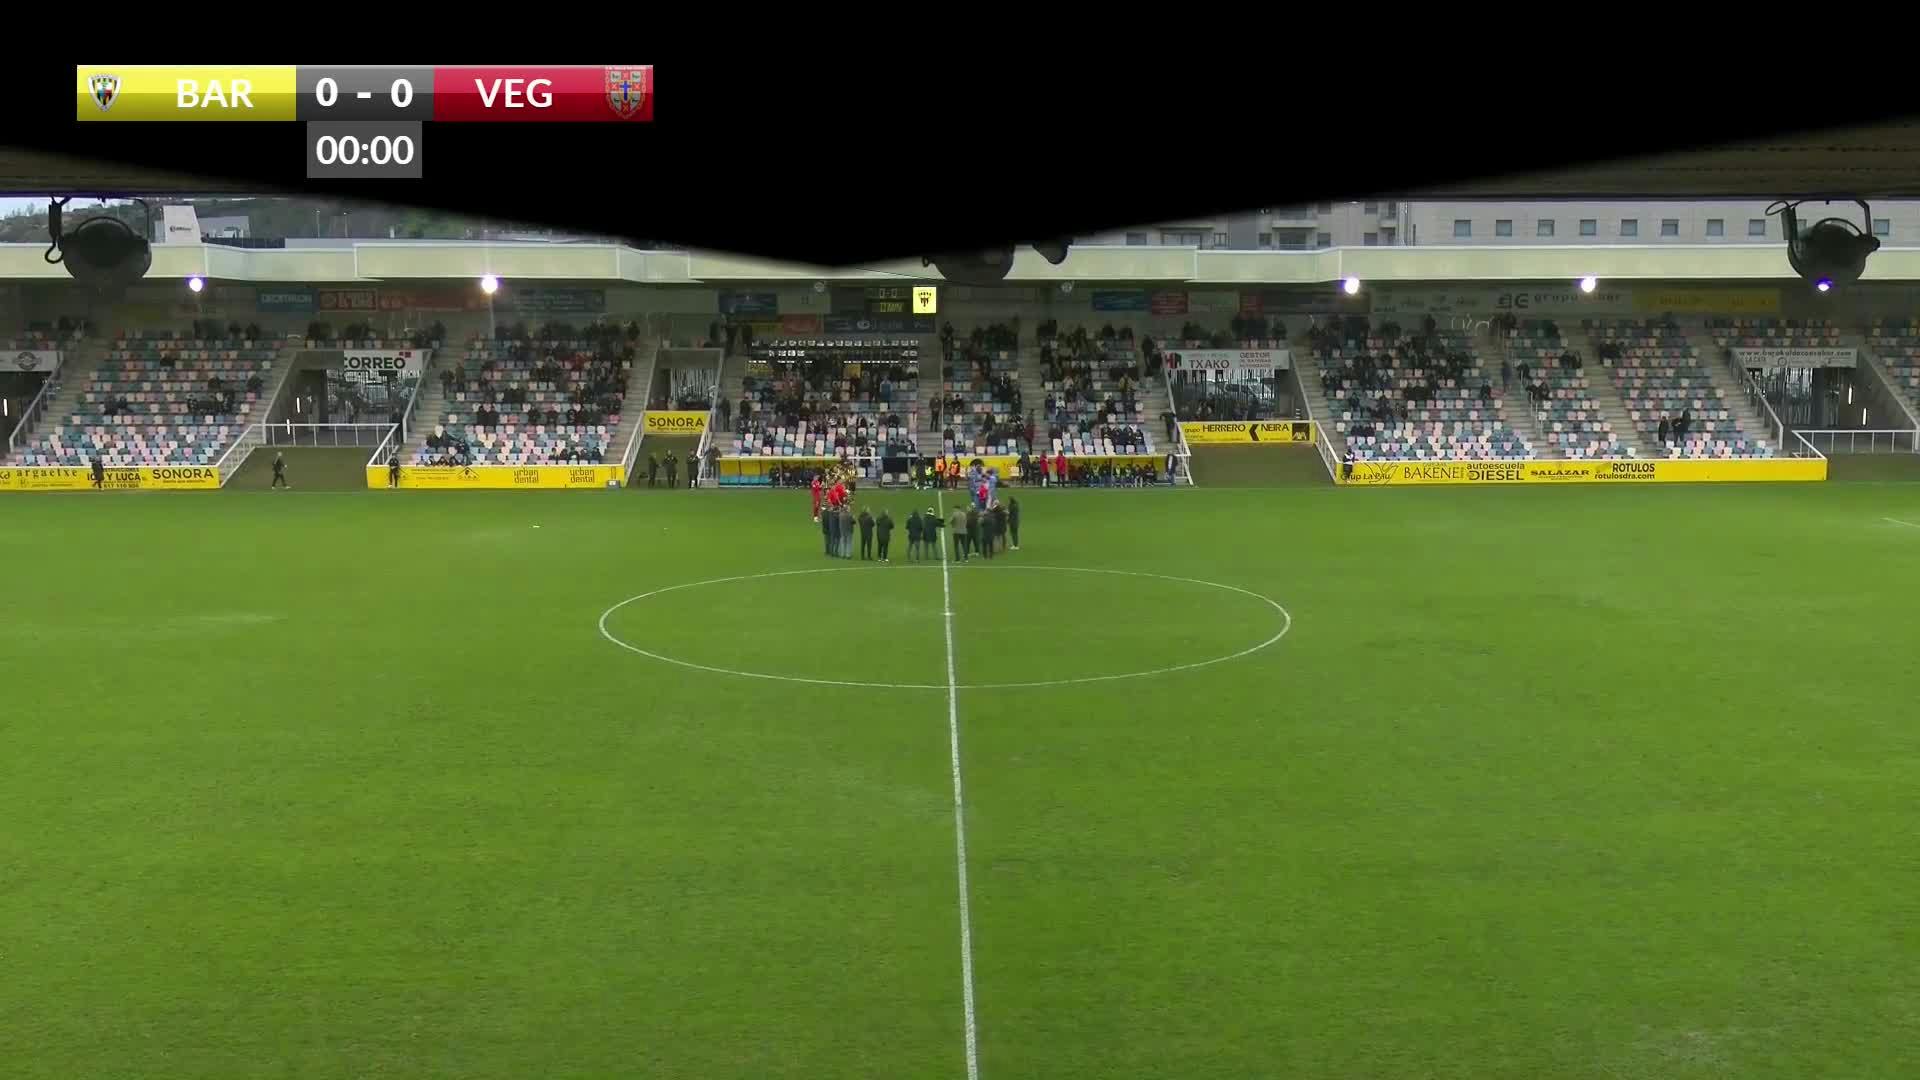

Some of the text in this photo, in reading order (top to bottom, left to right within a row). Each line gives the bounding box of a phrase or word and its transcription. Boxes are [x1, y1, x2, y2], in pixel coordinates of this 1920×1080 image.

[1189, 359, 1230, 369] TXAKO
[649, 417, 704, 427] SONORA
[1203, 424, 1246, 432] HERRERO
[514, 467, 538, 477] urban
[570, 467, 594, 477] urban
[1613, 463, 1655, 472] ROTULOS
[106, 473, 113, 481] Y
[116, 473, 141, 481] LUCA
[152, 468, 214, 479] SONORA
[1469, 470, 1525, 481] DIESEL
[515, 476, 538, 484] dental
[571, 476, 594, 484] dental
